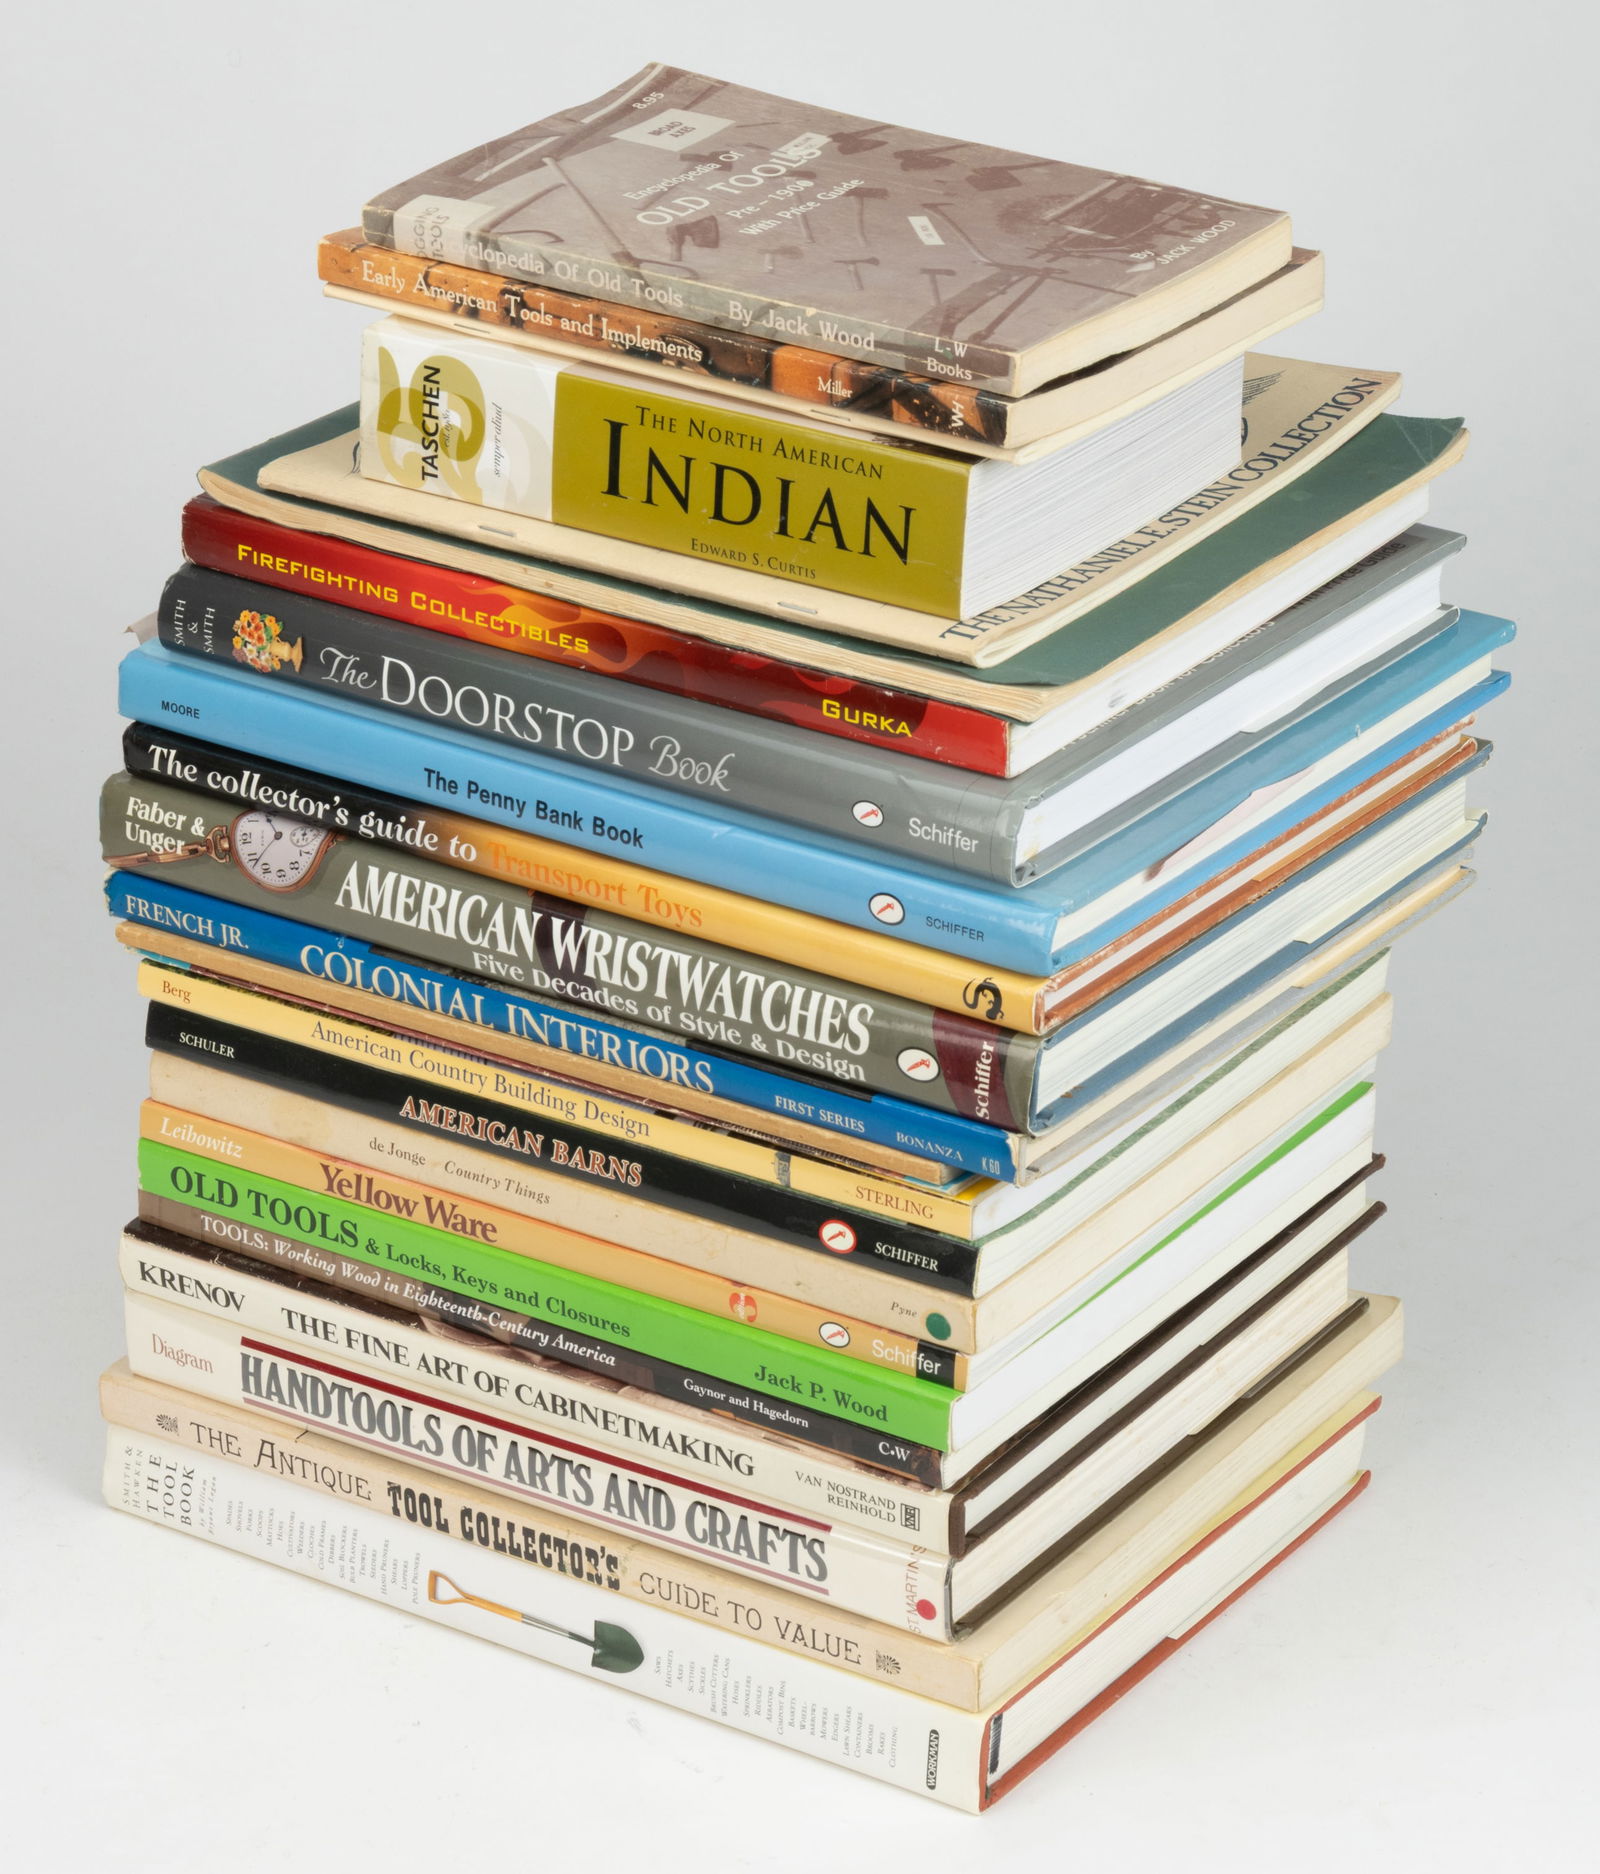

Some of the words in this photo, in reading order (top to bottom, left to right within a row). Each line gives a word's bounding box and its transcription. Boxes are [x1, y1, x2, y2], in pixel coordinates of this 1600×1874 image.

[632, 91, 664, 110] 8.95
[670, 125, 696, 139] AXES
[623, 161, 721, 201] Encyclopedia
[719, 150, 745, 162] Of
[768, 180, 814, 201] 1900
[636, 196, 710, 225] OLD
[739, 218, 782, 235] With
[1129, 249, 1155, 260] By
[1156, 244, 1196, 265] JACK
[1190, 220, 1236, 243] WOOD
[361, 259, 406, 293] Early
[412, 273, 498, 313] American
[504, 293, 554, 327] Tools
[560, 313, 594, 337] and
[599, 317, 703, 363] Implements
[555, 261, 580, 283] Of
[588, 269, 621, 292] Old
[630, 278, 684, 308] Tools
[728, 300, 752, 327] By
[762, 310, 809, 337] Jack
[819, 320, 876, 351] Wood
[926, 357, 973, 381] Books
[934, 336, 968, 358] L-W
[817, 375, 854, 400] Miller
[421, 365, 440, 480] TASCHEN
[635, 405, 678, 433] THE
[688, 417, 763, 453] NORTH
[772, 437, 884, 480] AMERICAN
[1226, 377, 1384, 483] COLLECTION
[600, 418, 917, 566] INDIAN
[1159, 478, 1247, 529] STEIN
[691, 538, 747, 563] EDWARD
[752, 552, 765, 568] S.
[767, 556, 816, 580] CURTIS
[1143, 523, 1178, 547] E.
[237, 544, 399, 603] FIREFIGHTING
[410, 590, 590, 654] COLLECTIBLES
[1001, 530, 1153, 625] NATHANIEL
[174, 598, 186, 646] SMITH
[203, 607, 216, 655] SMITH
[939, 603, 1016, 640] THE
[161, 700, 201, 720] MOORE
[319, 646, 378, 690] The
[379, 654, 635, 768] DOORSTOP
[649, 735, 736, 792] Book
[822, 699, 913, 738] GURKA
[126, 796, 187, 832] Faber
[190, 815, 206, 838] &
[424, 767, 459, 795] The
[467, 780, 526, 818] Penny
[536, 799, 584, 832] Bank
[592, 815, 644, 849] Book
[125, 821, 185, 856] Unger
[148, 744, 197, 784] The
[206, 767, 349, 827] collector's
[359, 812, 439, 851] guide
[448, 835, 478, 862] to
[487, 841, 627, 905] Transport
[637, 883, 704, 929] Toys
[908, 817, 979, 853] Schiffer
[125, 894, 214, 939] FRENCH
[219, 923, 249, 950] JR.
[925, 915, 985, 943] SCHIFFER
[334, 859, 540, 963] AMERICAN
[550, 916, 874, 1056] WRISTWATCHES
[161, 980, 192, 1004] Berg
[300, 944, 493, 1030] COLONIAL
[506, 1003, 714, 1095] INTERIORS
[473, 951, 525, 983] Five
[532, 972, 639, 1016] Decades
[649, 1002, 672, 1023] of
[679, 1010, 742, 1046] Style
[751, 1032, 768, 1053] &
[776, 1038, 867, 1082] Design
[178, 1031, 236, 1059] SCHULER
[310, 1020, 402, 1064] American
[409, 1049, 488, 1093] Country
[494, 1073, 577, 1122] Building
[583, 1099, 650, 1139] Design
[974, 1040, 995, 1121] Schiffer
[160, 1117, 244, 1159] Leibowitz
[775, 1095, 815, 1118] FIRST
[819, 1109, 865, 1134] SERIES
[387, 1143, 426, 1167] Jonge
[399, 1095, 545, 1158] AMERICAN
[550, 1137, 643, 1187] BARNS
[896, 1131, 964, 1162] BONANZA
[444, 1160, 501, 1189] Country
[504, 1177, 551, 1205] Things
[982, 1157, 989, 1172] K
[990, 1159, 1000, 1176] 60
[319, 1162, 419, 1218] Yellow
[423, 1194, 498, 1243] Ware
[855, 1185, 934, 1219] STERLING
[170, 1165, 239, 1209] OLD
[247, 1187, 360, 1248] TOOLS
[364, 1237, 381, 1255] &
[385, 1242, 447, 1280] Locks,
[452, 1265, 498, 1295] Keys
[504, 1285, 540, 1309] and
[546, 1297, 631, 1338] Closures
[874, 1241, 939, 1272] SCHIFFER
[137, 1260, 246, 1312] KRENOV
[201, 1213, 269, 1251] TOOLS:
[273, 1240, 336, 1275] Working
[340, 1261, 382, 1287] Wood
[384, 1276, 400, 1292] in
[402, 1283, 549, 1347] Eighteenth-Century
[552, 1335, 617, 1367] America
[890, 1301, 918, 1318] Pyne
[151, 1332, 214, 1374] Diagram
[872, 1339, 942, 1375] Schiffer
[280, 1307, 339, 1344] THE
[344, 1327, 410, 1368] FINE
[416, 1352, 469, 1385] ART
[474, 1370, 510, 1399] OF
[515, 1383, 755, 1477] CABINETMAKING
[683, 1377, 727, 1402] Gaynor
[729, 1392, 750, 1409] and
[752, 1400, 809, 1429] Hagedorn
[754, 1365, 803, 1394] Jack
[809, 1380, 827, 1402] P.
[833, 1389, 889, 1422] Wood
[123, 1462, 132, 1505] SMITH
[132, 1449, 144, 1509] HAWKEN
[146, 1454, 162, 1514] THE
[163, 1460, 178, 1520] TOOL
[240, 1352, 444, 1458] HANDTOOLS
[451, 1423, 499, 1473] OF
[503, 1440, 595, 1507] ARTS
[603, 1472, 676, 1533] AND
[685, 1499, 828, 1583] CRAFTS
[795, 1470, 823, 1488] VAN
[826, 1480, 897, 1510] NOSTRAND
[180, 1466, 196, 1528] BOOK
[826, 1494, 897, 1523] REINHOLD
[190, 1421, 243, 1458] THE
[253, 1438, 372, 1501] ANTIQUE
[386, 1480, 450, 1534] TOOL
[460, 1505, 621, 1591] COLLECTOR'S
[639, 1571, 719, 1618] GUIDE
[726, 1600, 763, 1631] TO
[773, 1615, 863, 1666] VALUE
[926, 1732, 939, 1788] WORKMAN
